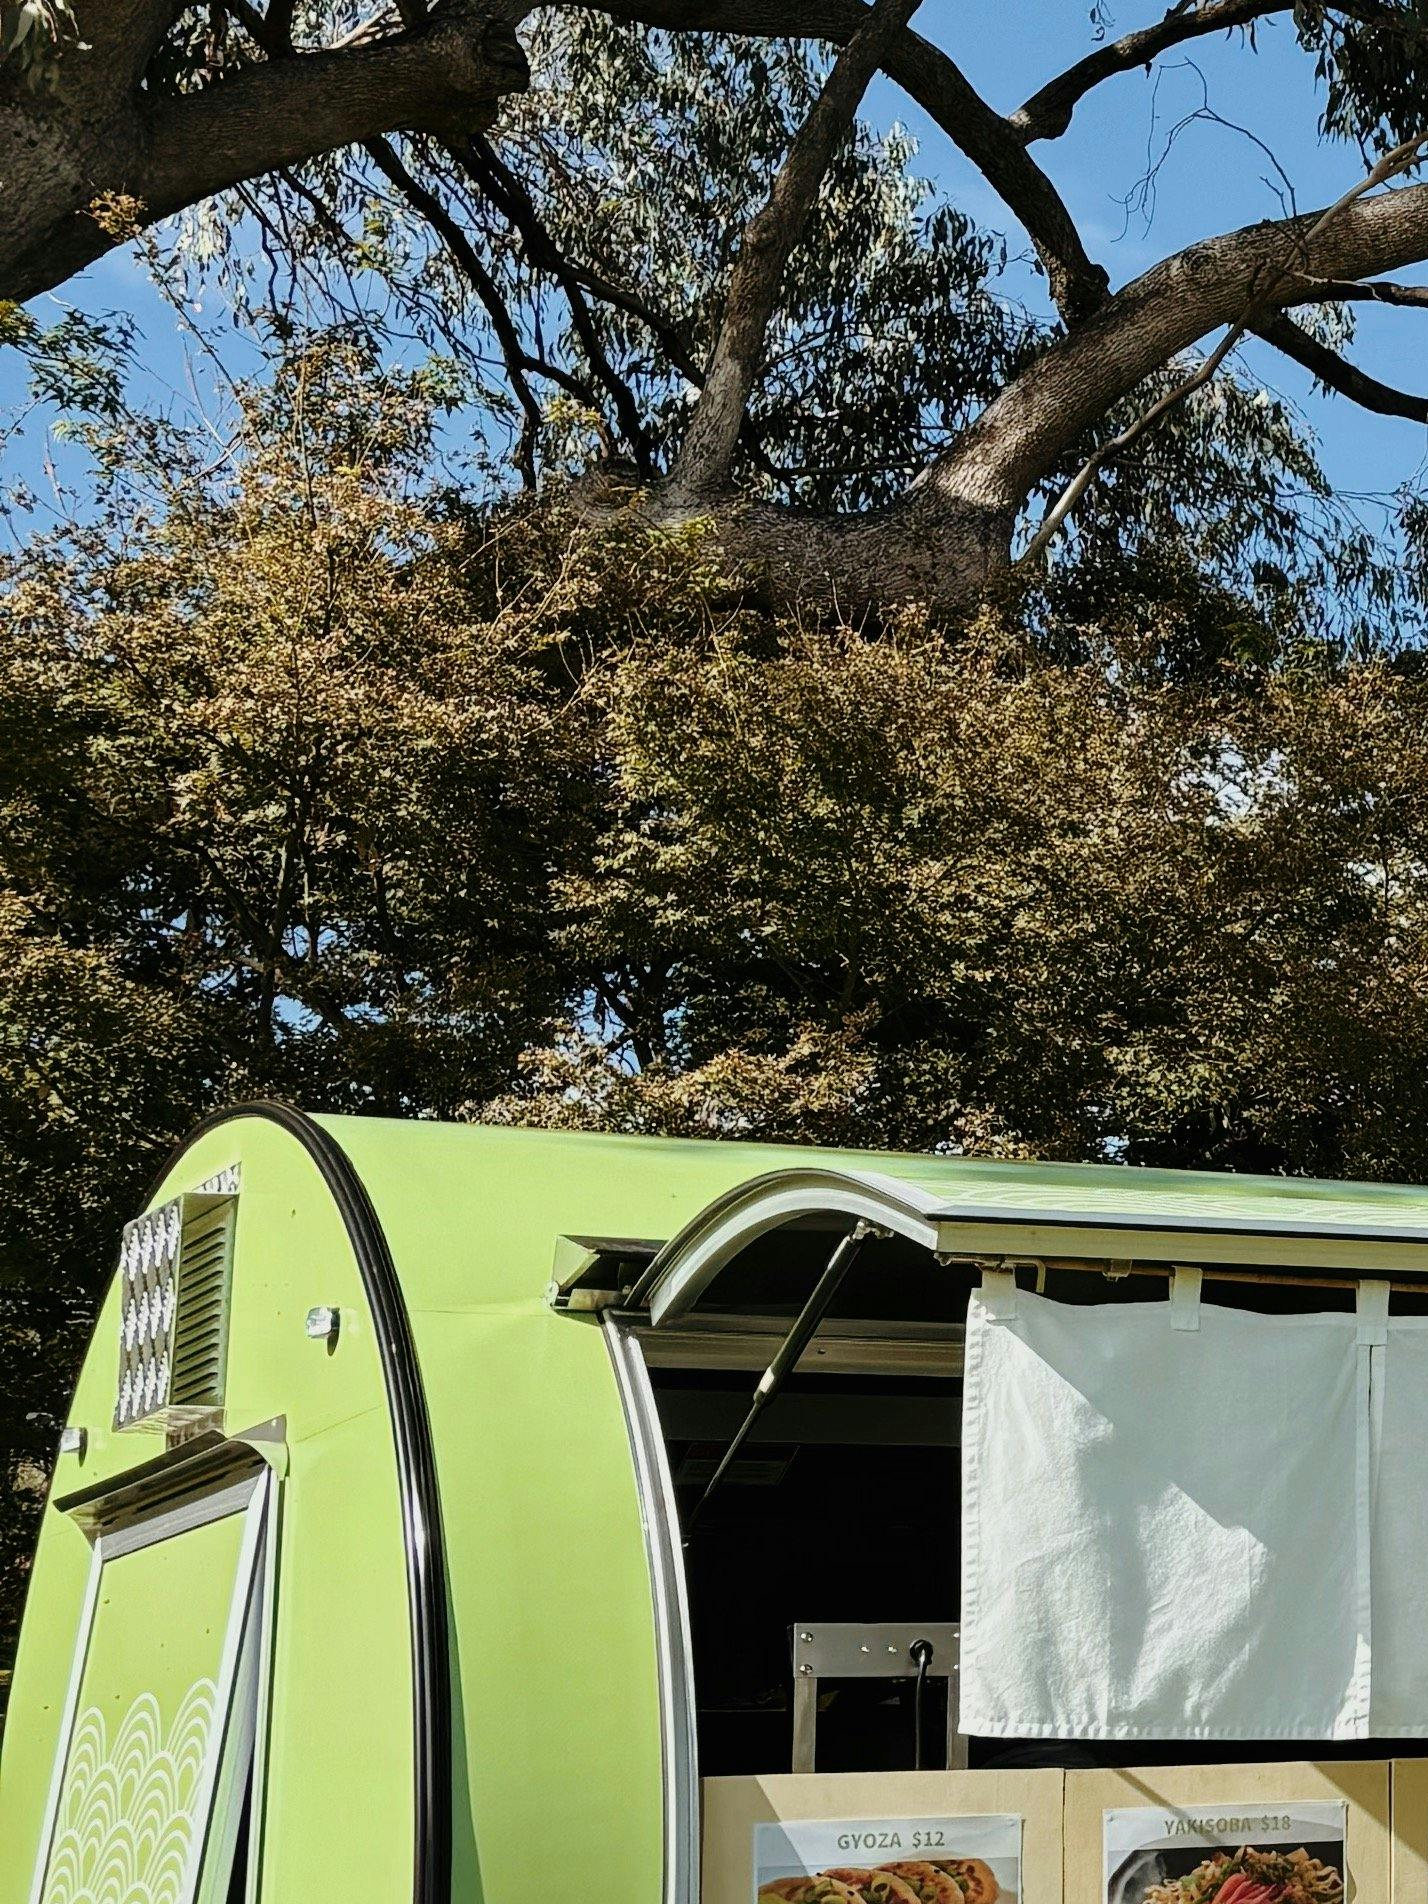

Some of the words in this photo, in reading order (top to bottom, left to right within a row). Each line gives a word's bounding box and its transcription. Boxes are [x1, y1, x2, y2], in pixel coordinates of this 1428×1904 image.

[1164, 1815, 1252, 1836] YAKISOBA
[1260, 1814, 1292, 1833] $18
[837, 1832, 902, 1850] GYOZA
[911, 1830, 946, 1849] $12
